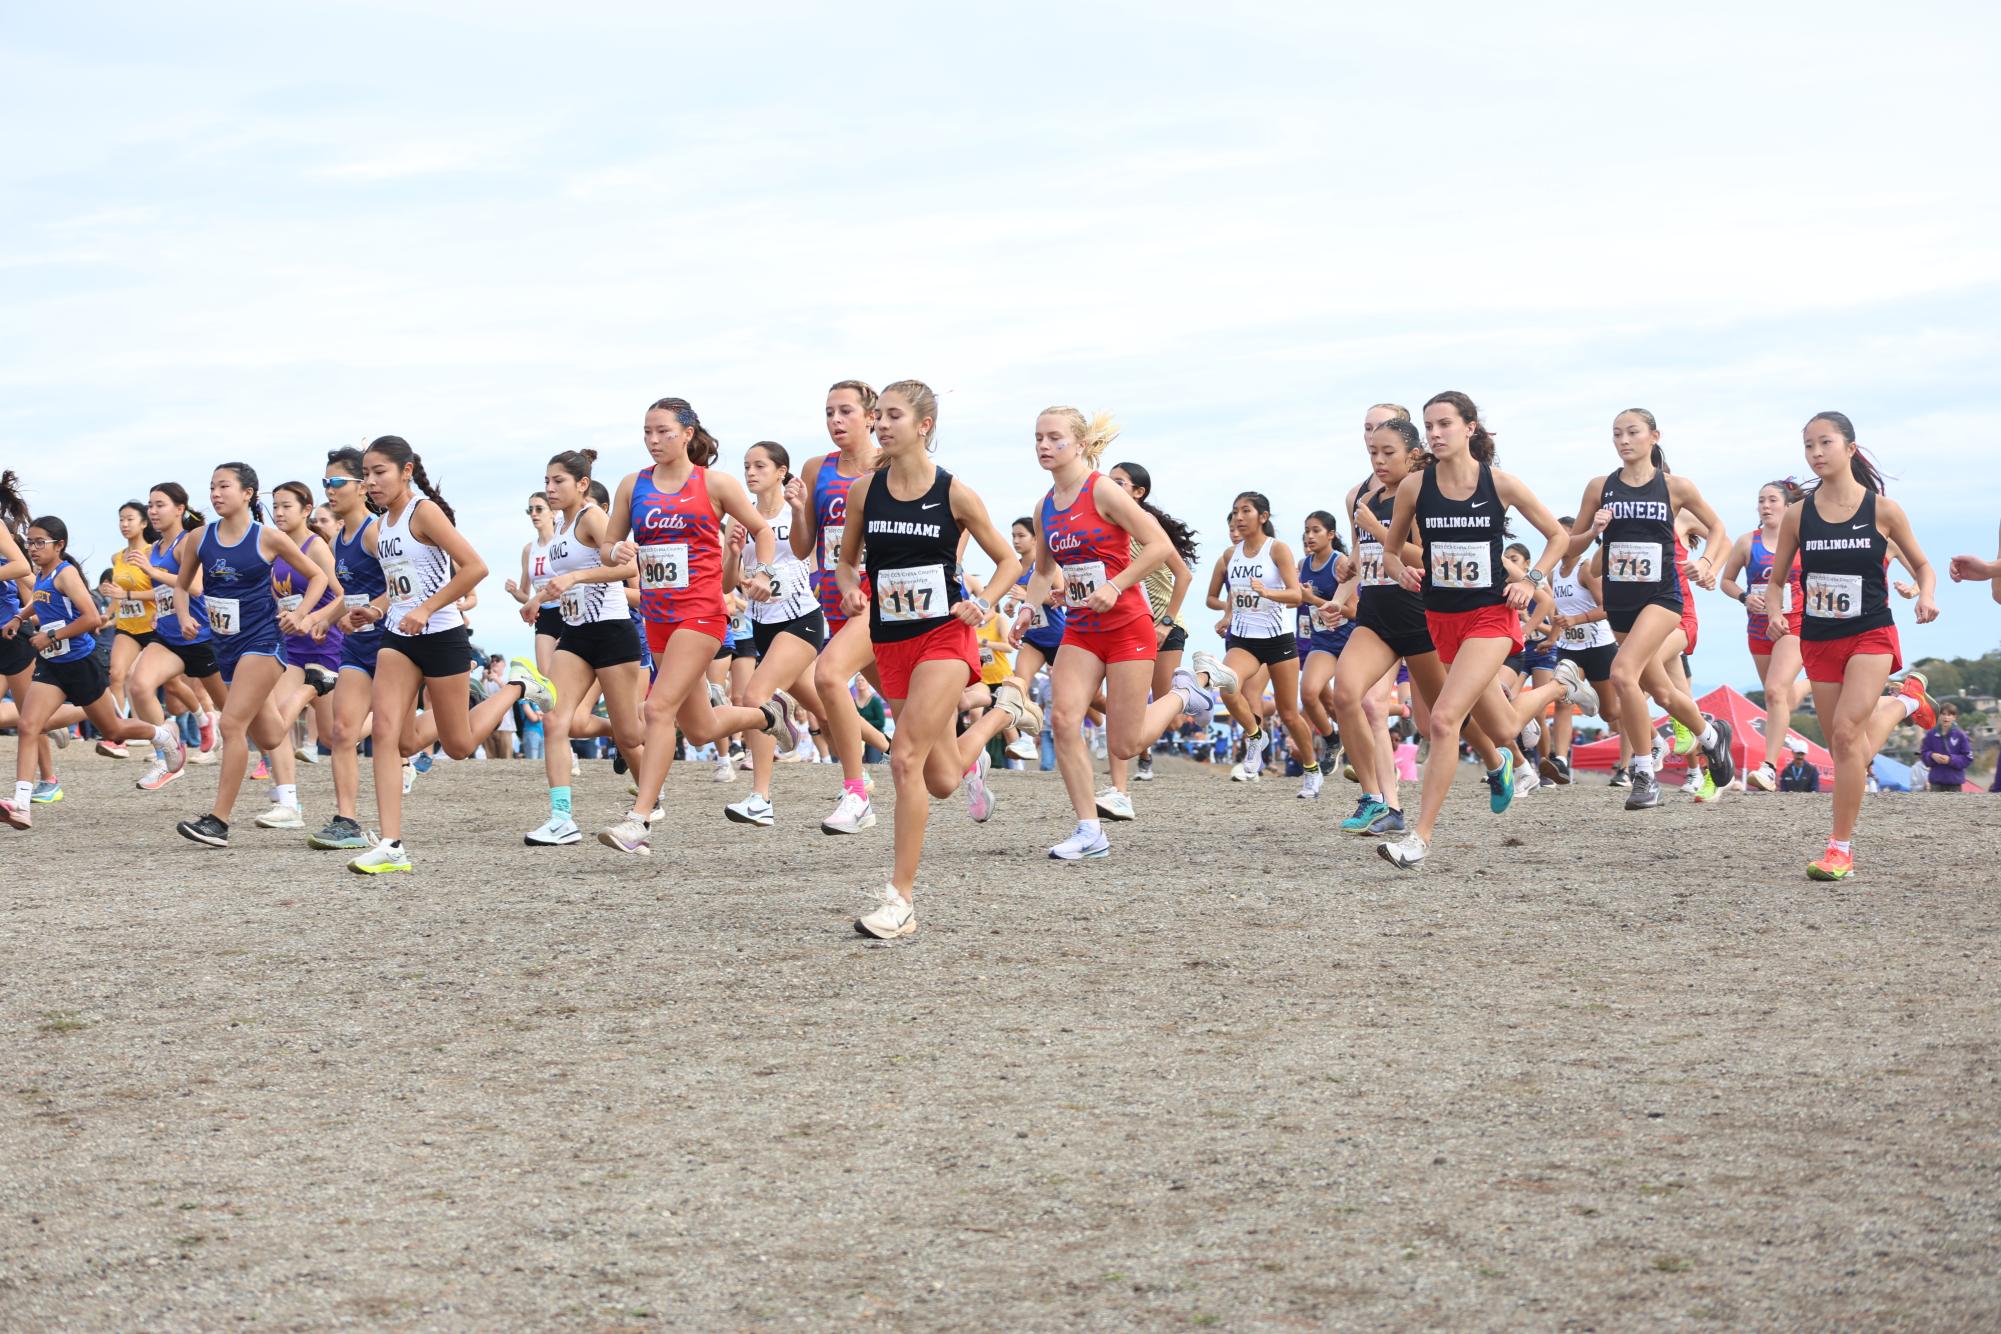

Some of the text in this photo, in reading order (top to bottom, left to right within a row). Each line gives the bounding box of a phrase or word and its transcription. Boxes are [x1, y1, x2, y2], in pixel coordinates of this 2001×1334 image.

[645, 508, 687, 529] Cats
[1425, 516, 1491, 529] BURLINGAME
[745, 526, 789, 544] NC
[868, 520, 941, 538] BURLINGAME
[377, 537, 403, 559] NMC
[549, 541, 569, 561] NMC
[1049, 531, 1082, 552] Cats
[1805, 538, 1871, 551] BURLINGAME
[646, 562, 678, 582] 903
[1230, 565, 1263, 579] NMC
[1441, 560, 1480, 581] 113
[1617, 558, 1651, 577] 713
[889, 587, 933, 613] 117
[1069, 580, 1095, 601] 901
[1553, 585, 1574, 599] NMC
[1236, 594, 1260, 608] 607
[1815, 591, 1851, 613] 116
[1564, 627, 1585, 640] 608
